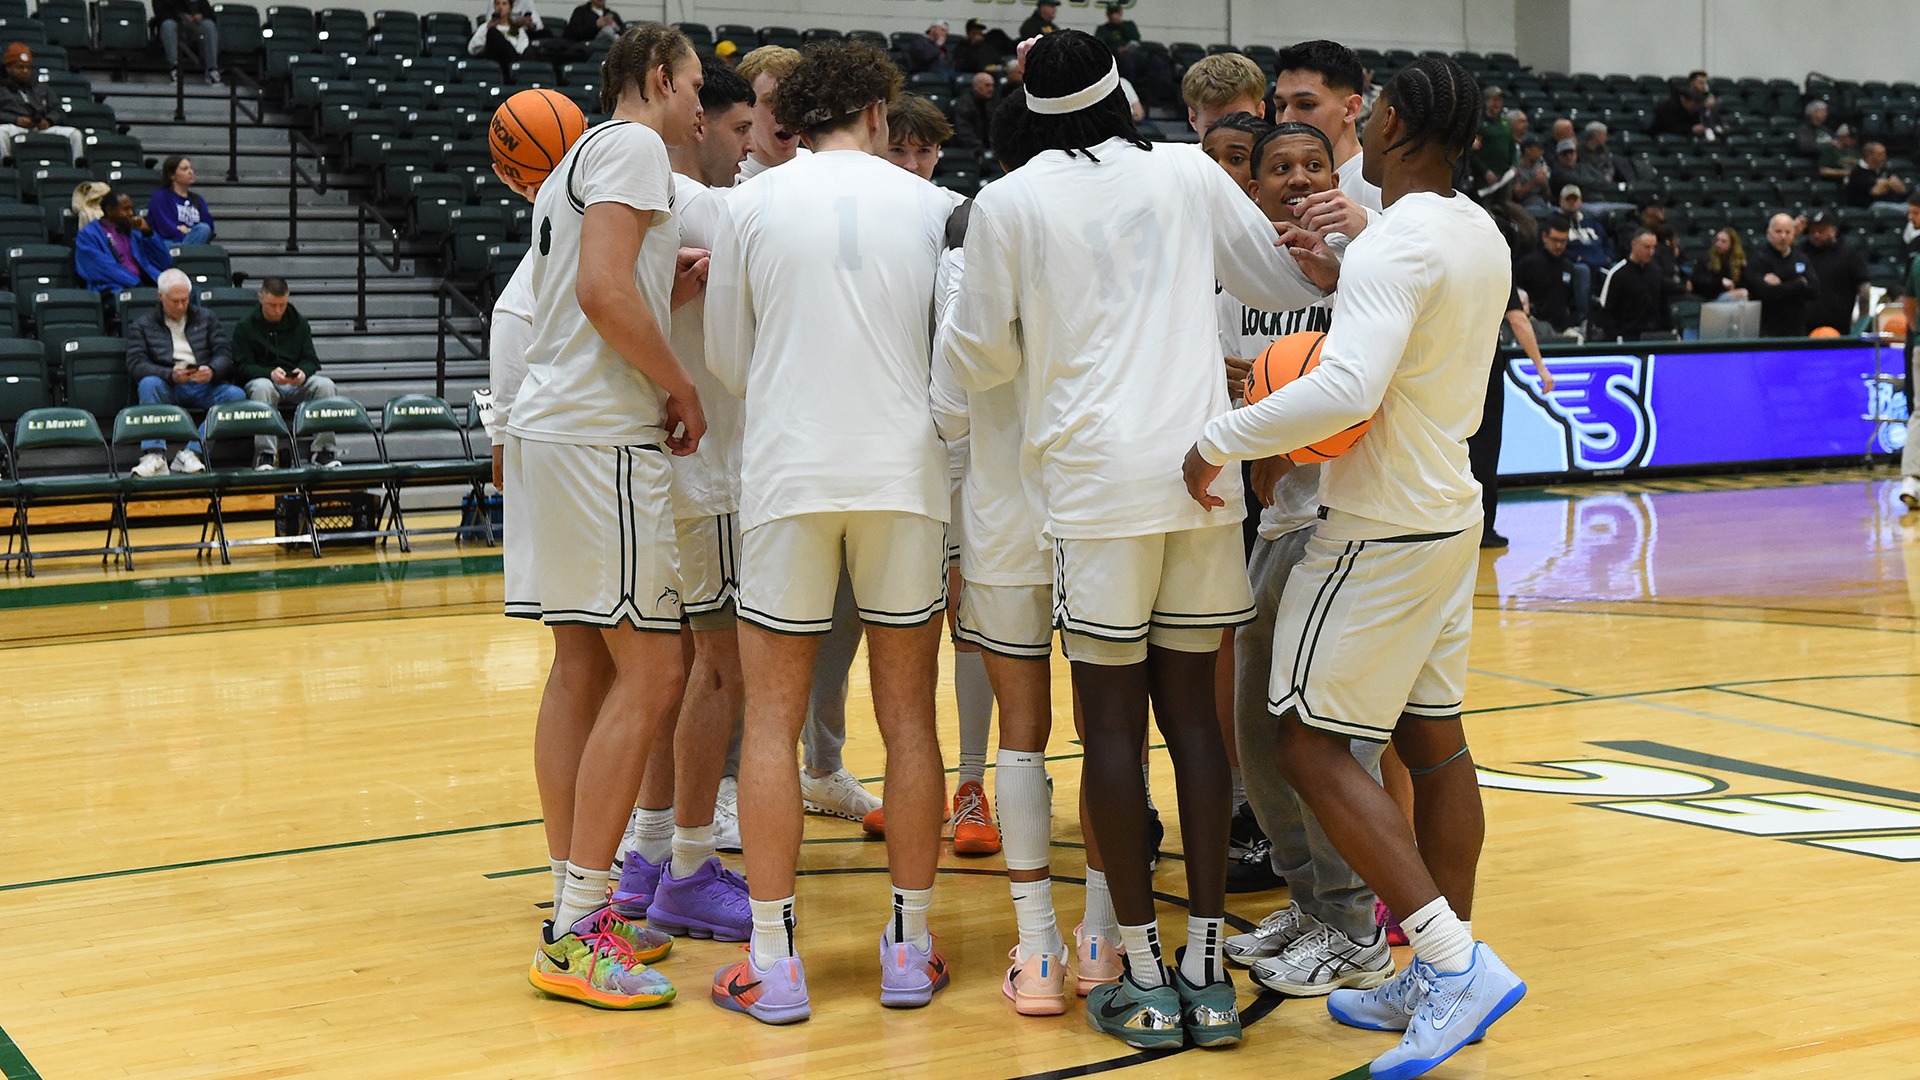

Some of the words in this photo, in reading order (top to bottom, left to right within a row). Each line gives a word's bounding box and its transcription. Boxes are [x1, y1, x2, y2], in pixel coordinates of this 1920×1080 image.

[833, 196, 863, 271] 1
[1241, 305, 1283, 336] LOCK
[1284, 307, 1306, 336] IT
[1305, 306, 1333, 335] IN
[233, 410, 272, 420] MOYNE
[320, 408, 357, 418] MOYNE
[408, 406, 445, 415] MOYNE
[45, 419, 87, 429] MOYNE
[142, 414, 181, 424] MOYNE
